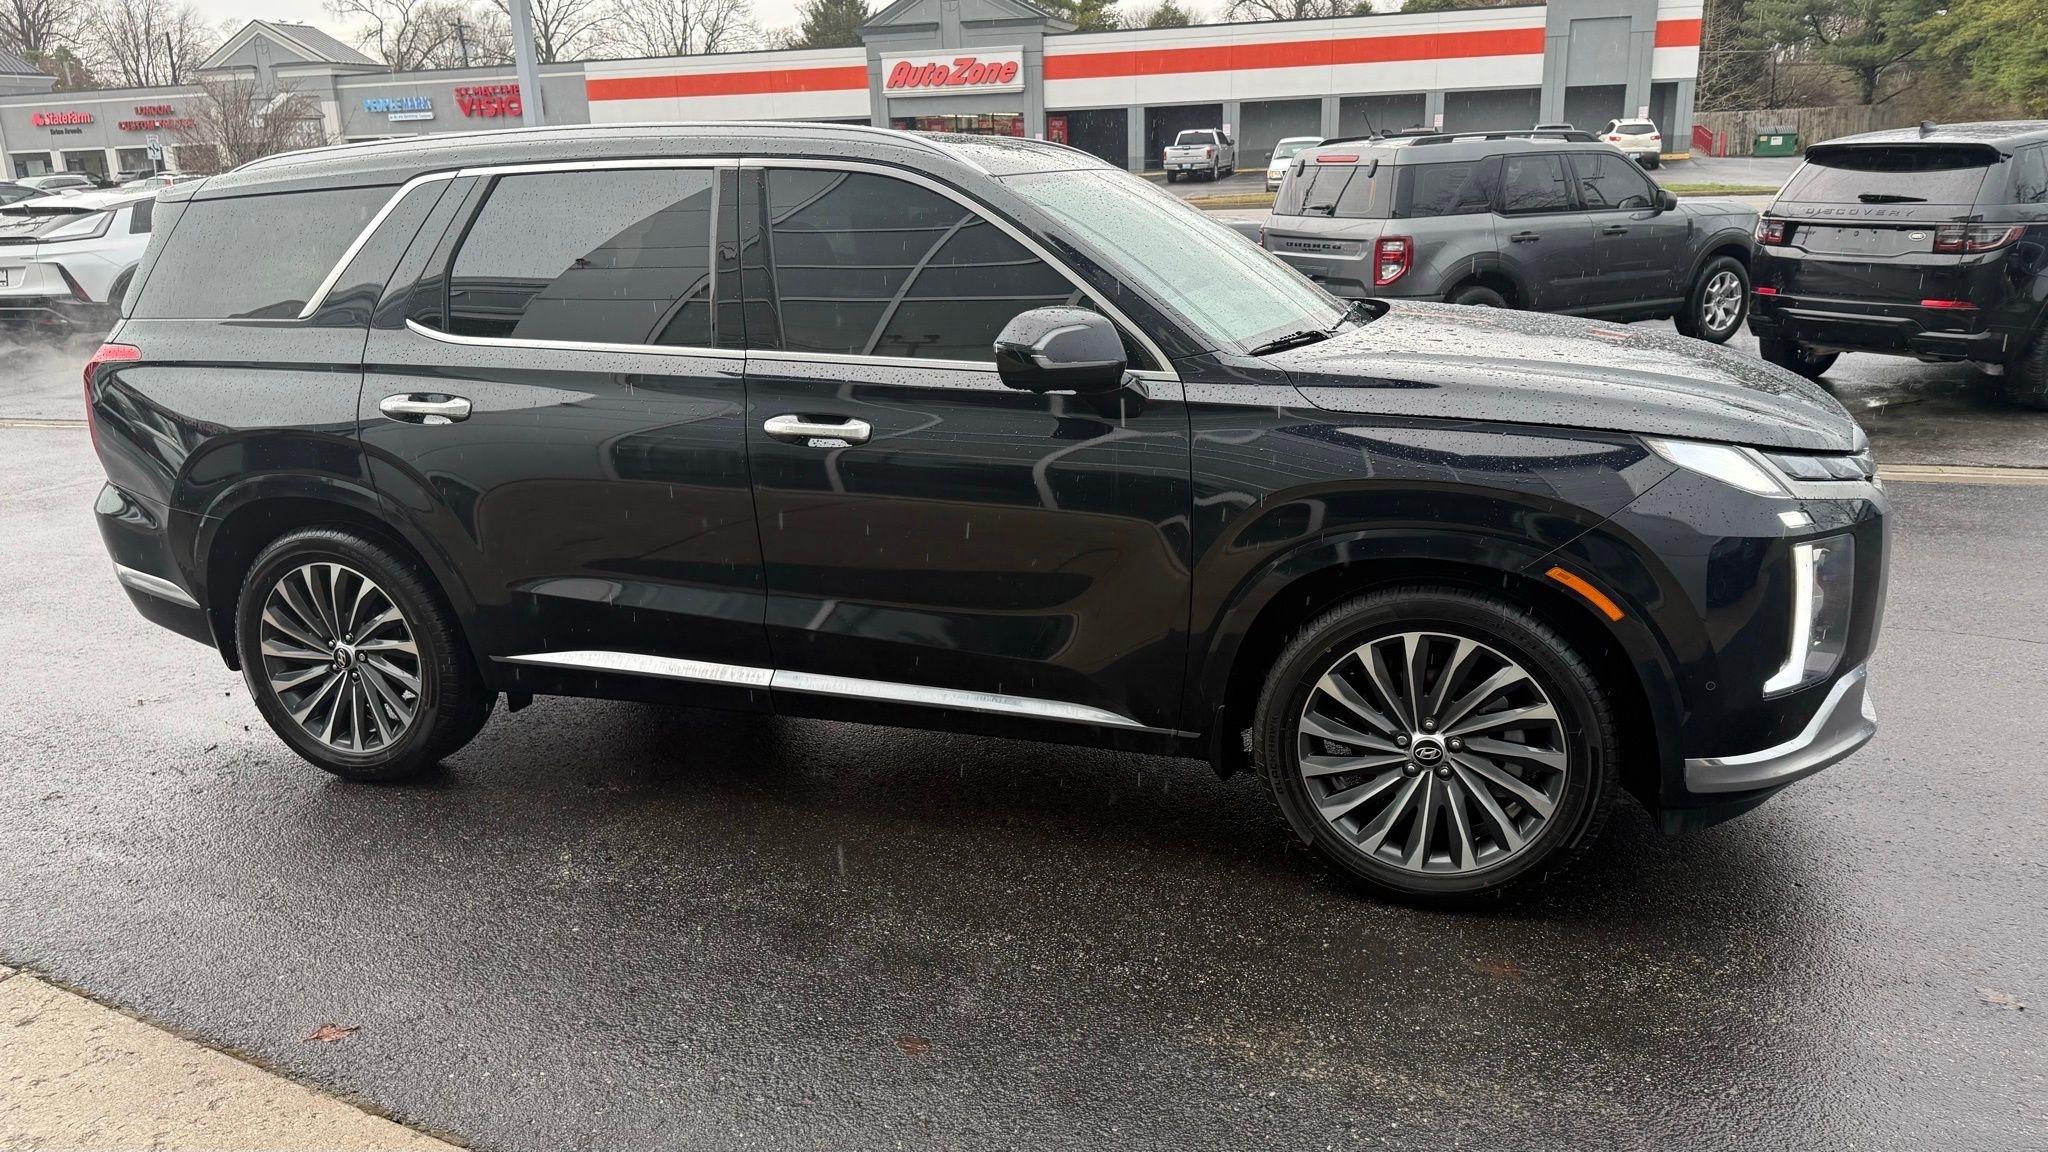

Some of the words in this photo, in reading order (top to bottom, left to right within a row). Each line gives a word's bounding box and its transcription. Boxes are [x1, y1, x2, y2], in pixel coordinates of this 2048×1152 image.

[886, 57, 1019, 88] AutoZone
[456, 96, 523, 117] VISIO
[1805, 207, 1915, 217] DISCOVERY
